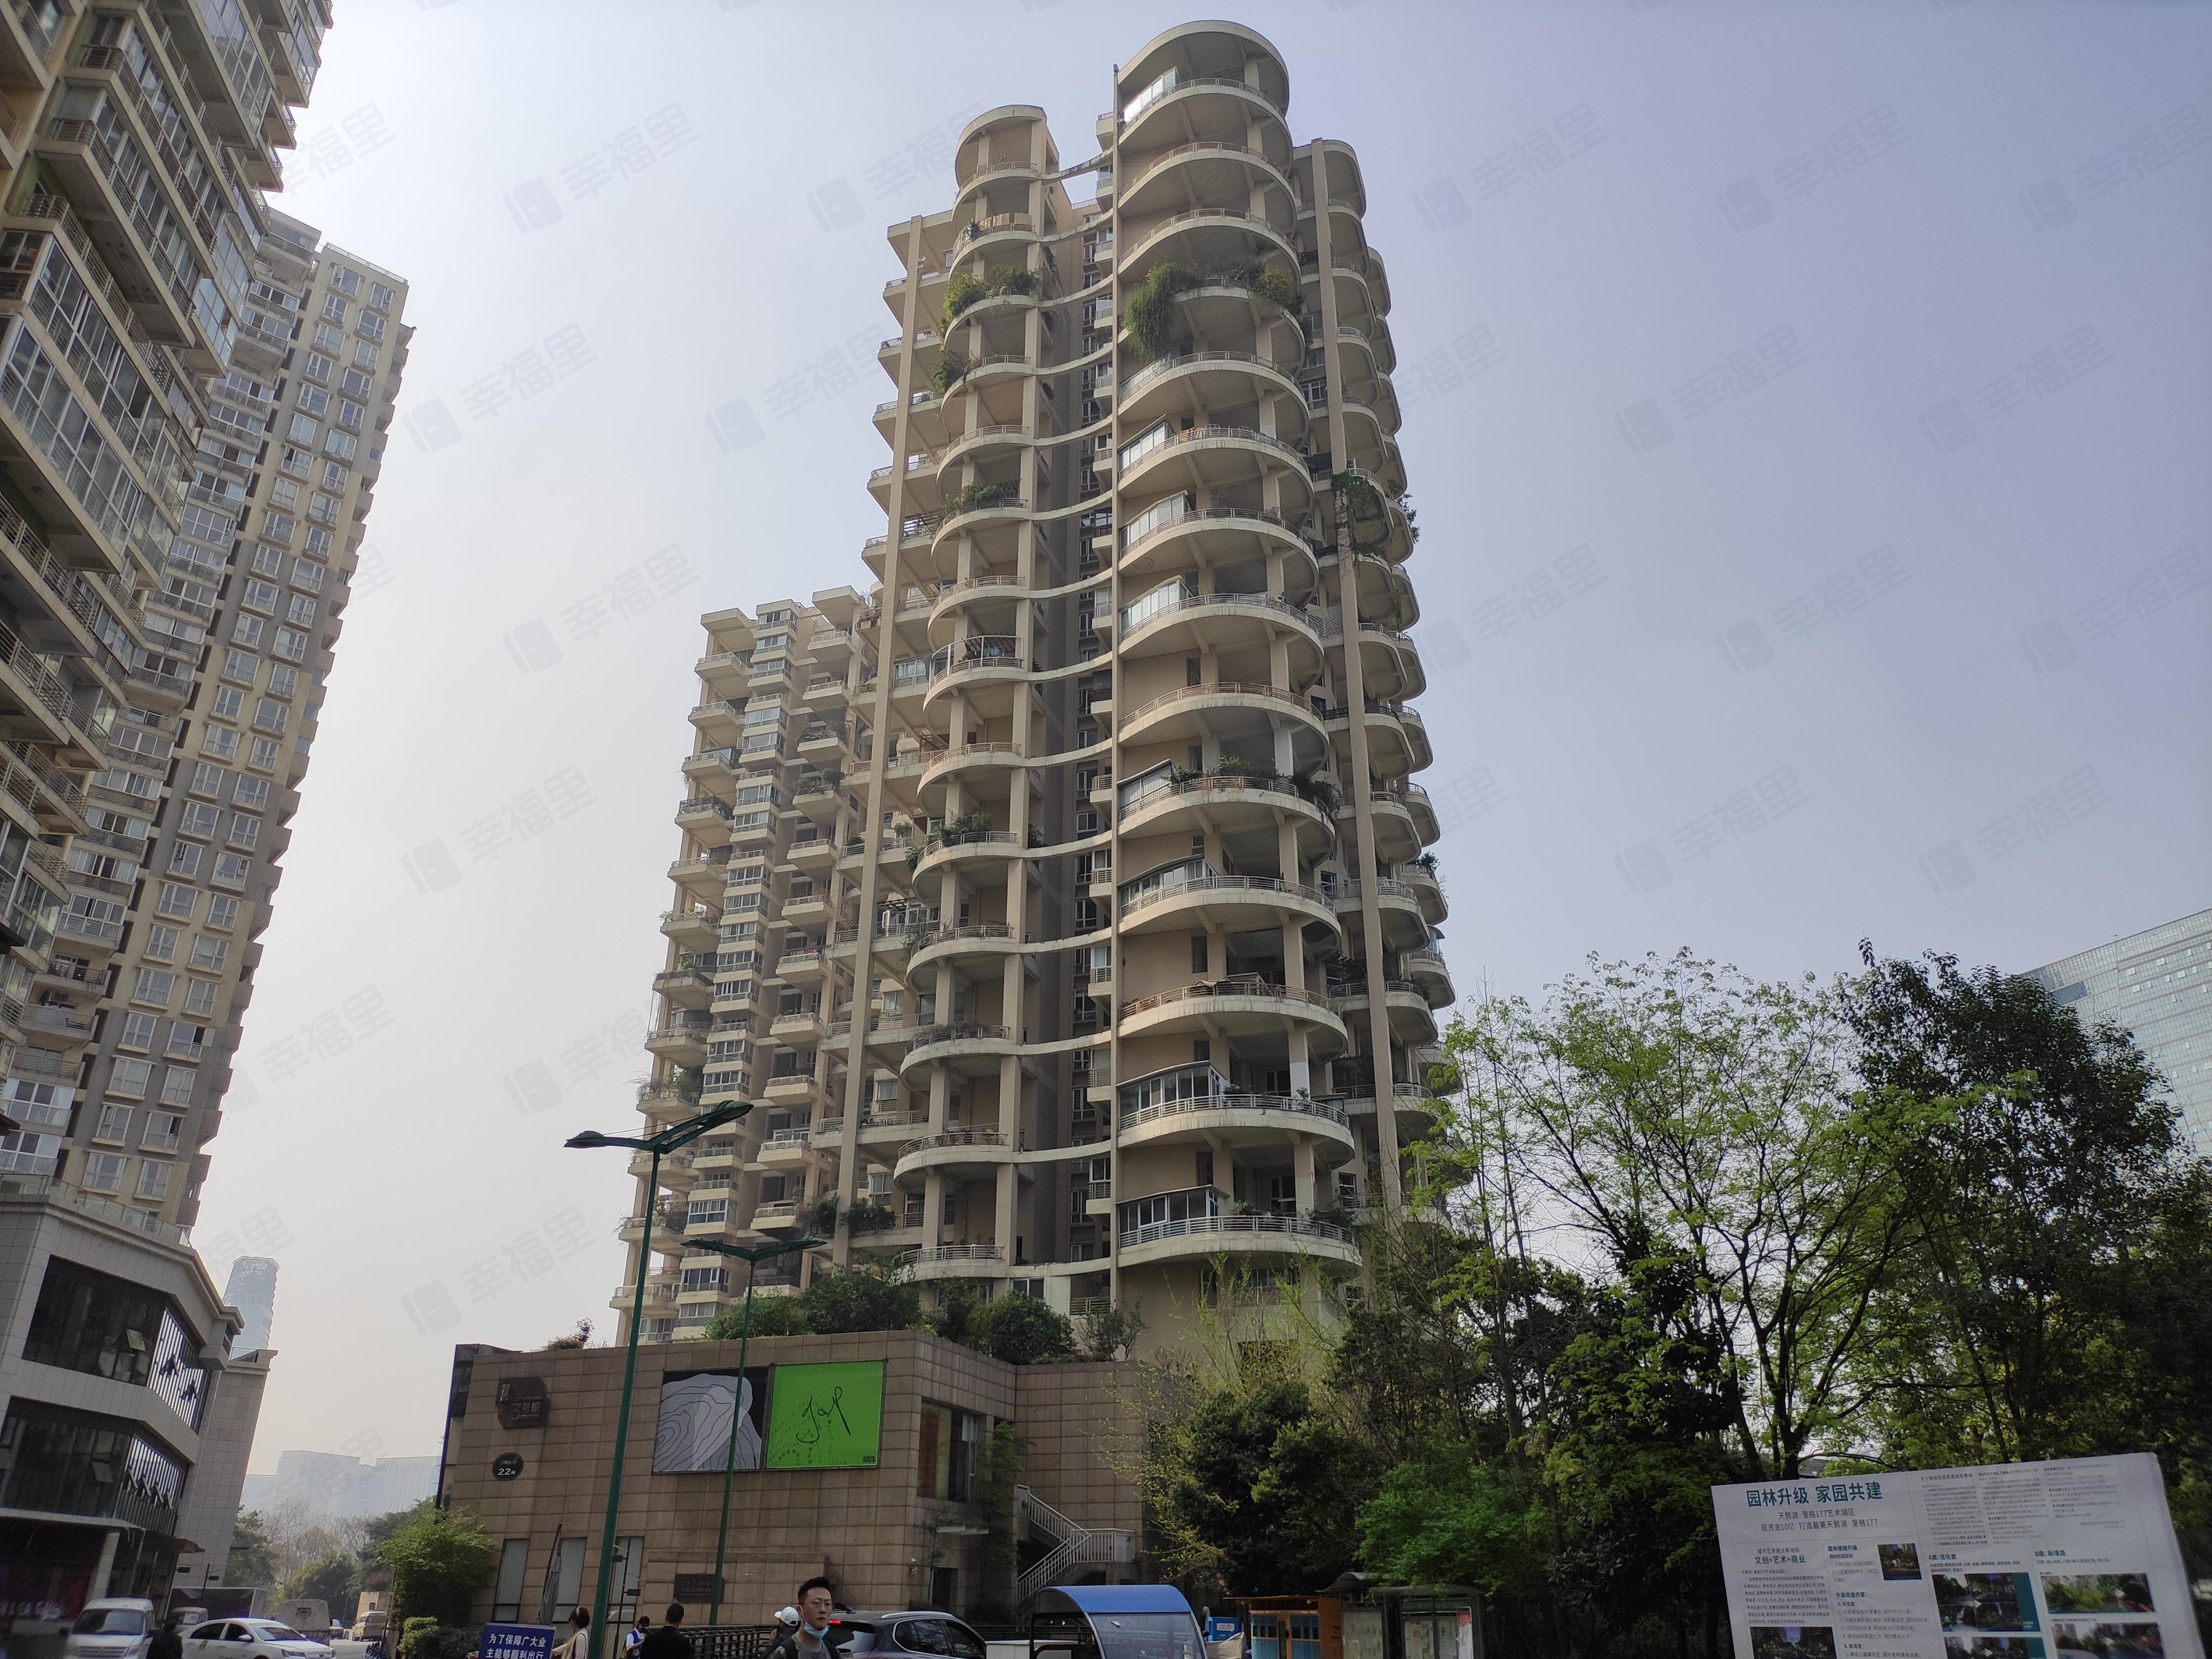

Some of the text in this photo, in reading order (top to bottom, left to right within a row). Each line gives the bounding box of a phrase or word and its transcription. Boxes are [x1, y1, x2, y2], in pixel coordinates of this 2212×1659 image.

[1746, 1481, 1882, 1507] 园林升级 家园共建
[1761, 1524, 1795, 1532] 投资逾10亿
[1755, 1554, 1806, 1564] 文创+艺术+商业
[488, 1634, 546, 1647] 为了保障广大业
[486, 1648, 544, 1659] 主能够顺利出行
